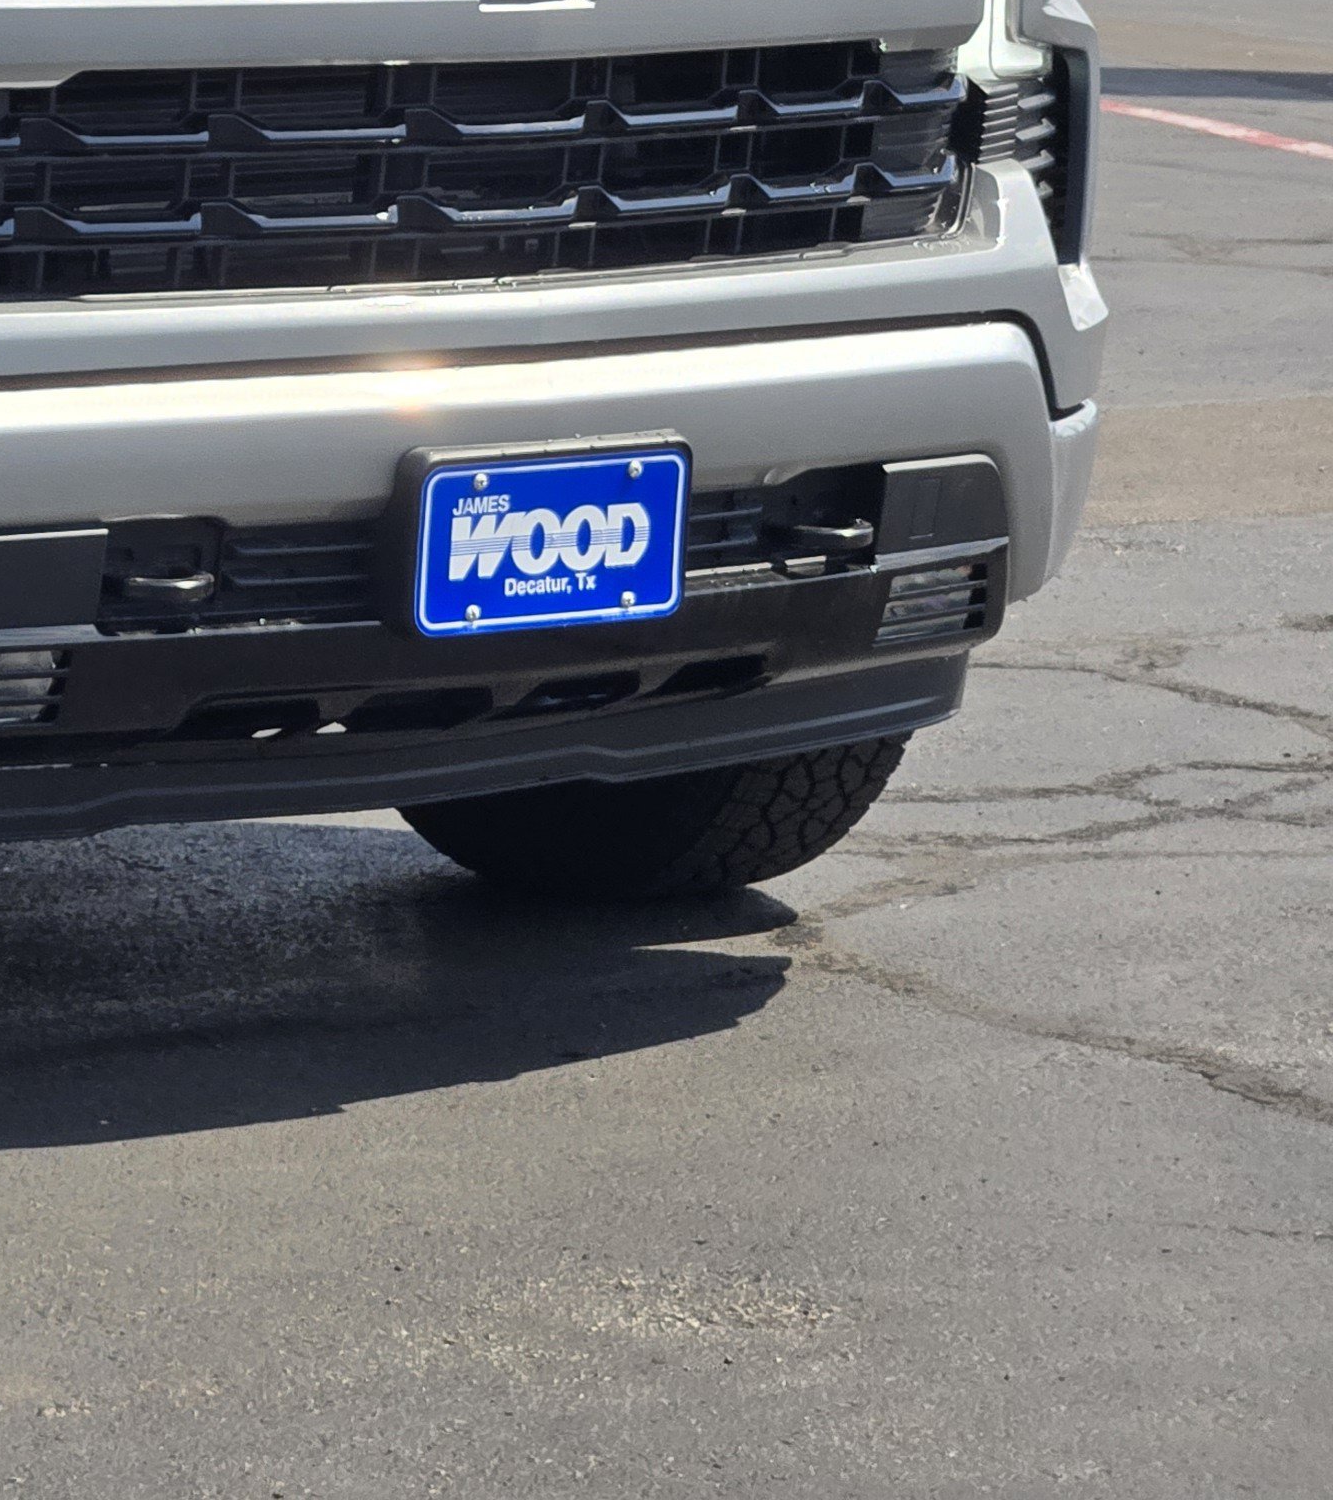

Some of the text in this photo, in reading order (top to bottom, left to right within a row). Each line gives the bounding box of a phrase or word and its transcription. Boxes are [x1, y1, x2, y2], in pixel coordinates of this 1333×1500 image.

[452, 494, 511, 516] JAMES
[448, 502, 651, 581] WOOD
[504, 576, 573, 598] Decatur,
